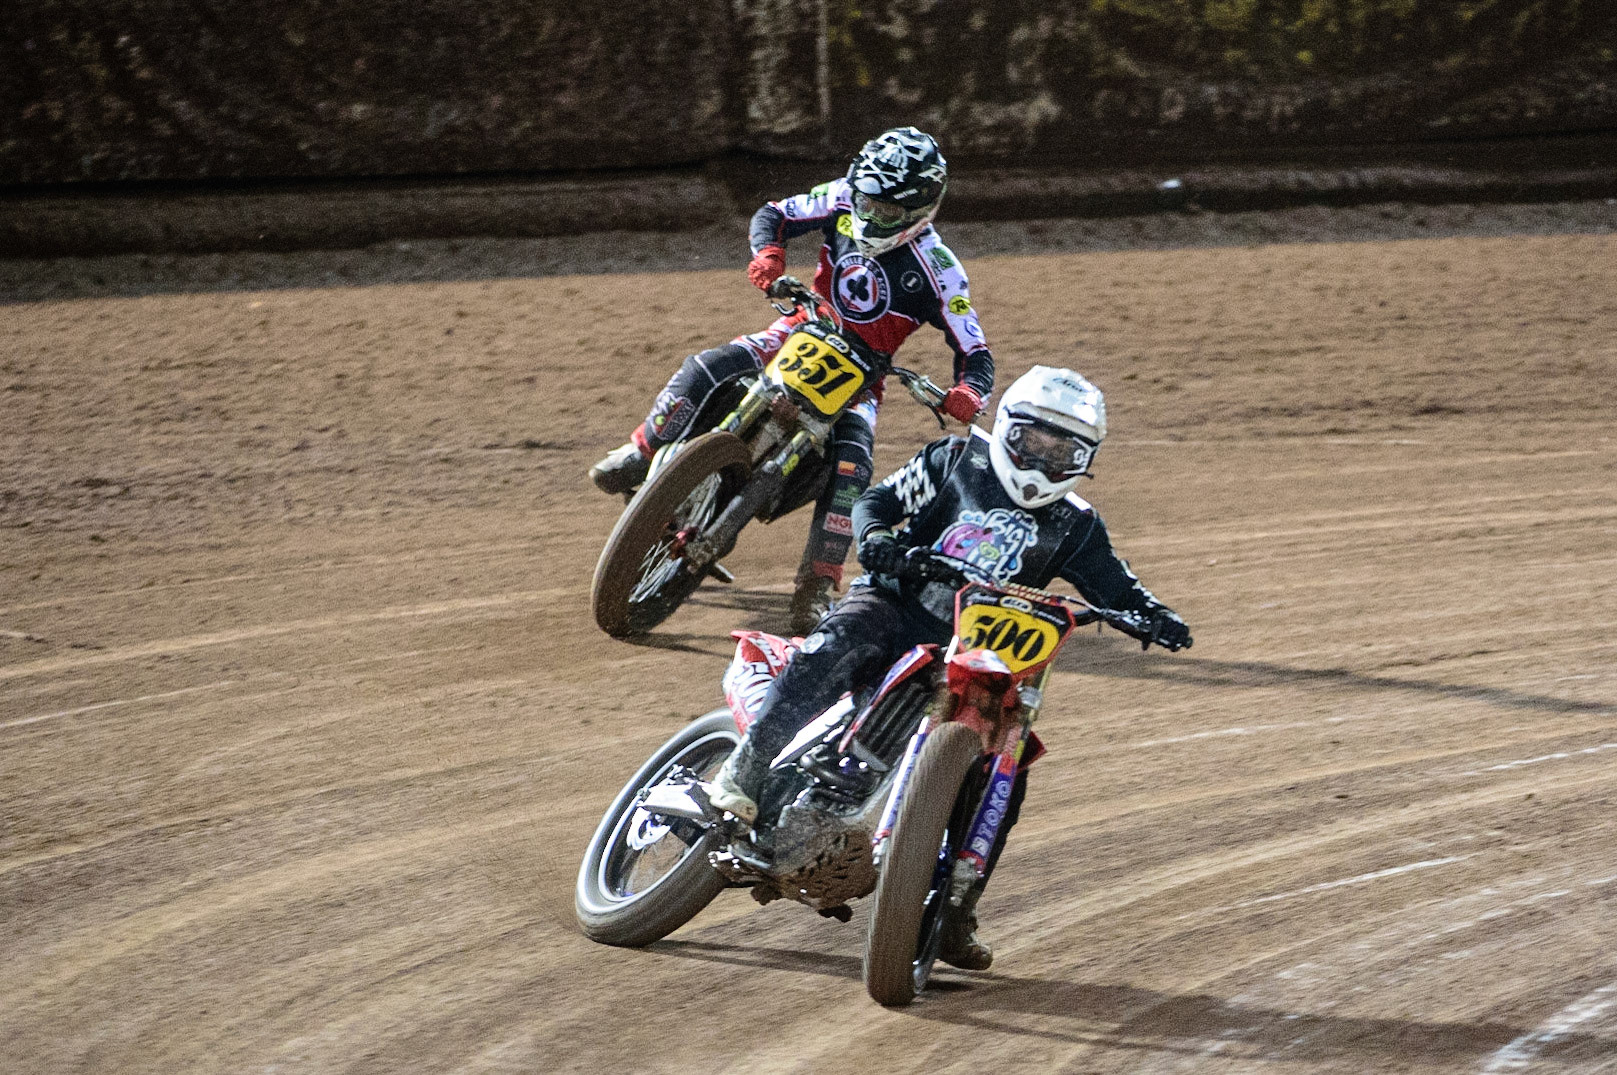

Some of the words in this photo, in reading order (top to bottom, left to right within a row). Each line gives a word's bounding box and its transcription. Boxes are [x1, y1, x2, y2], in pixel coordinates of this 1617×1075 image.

[841, 255, 864, 269] BELLE
[778, 342, 857, 398] 351
[961, 614, 1046, 662] 500
